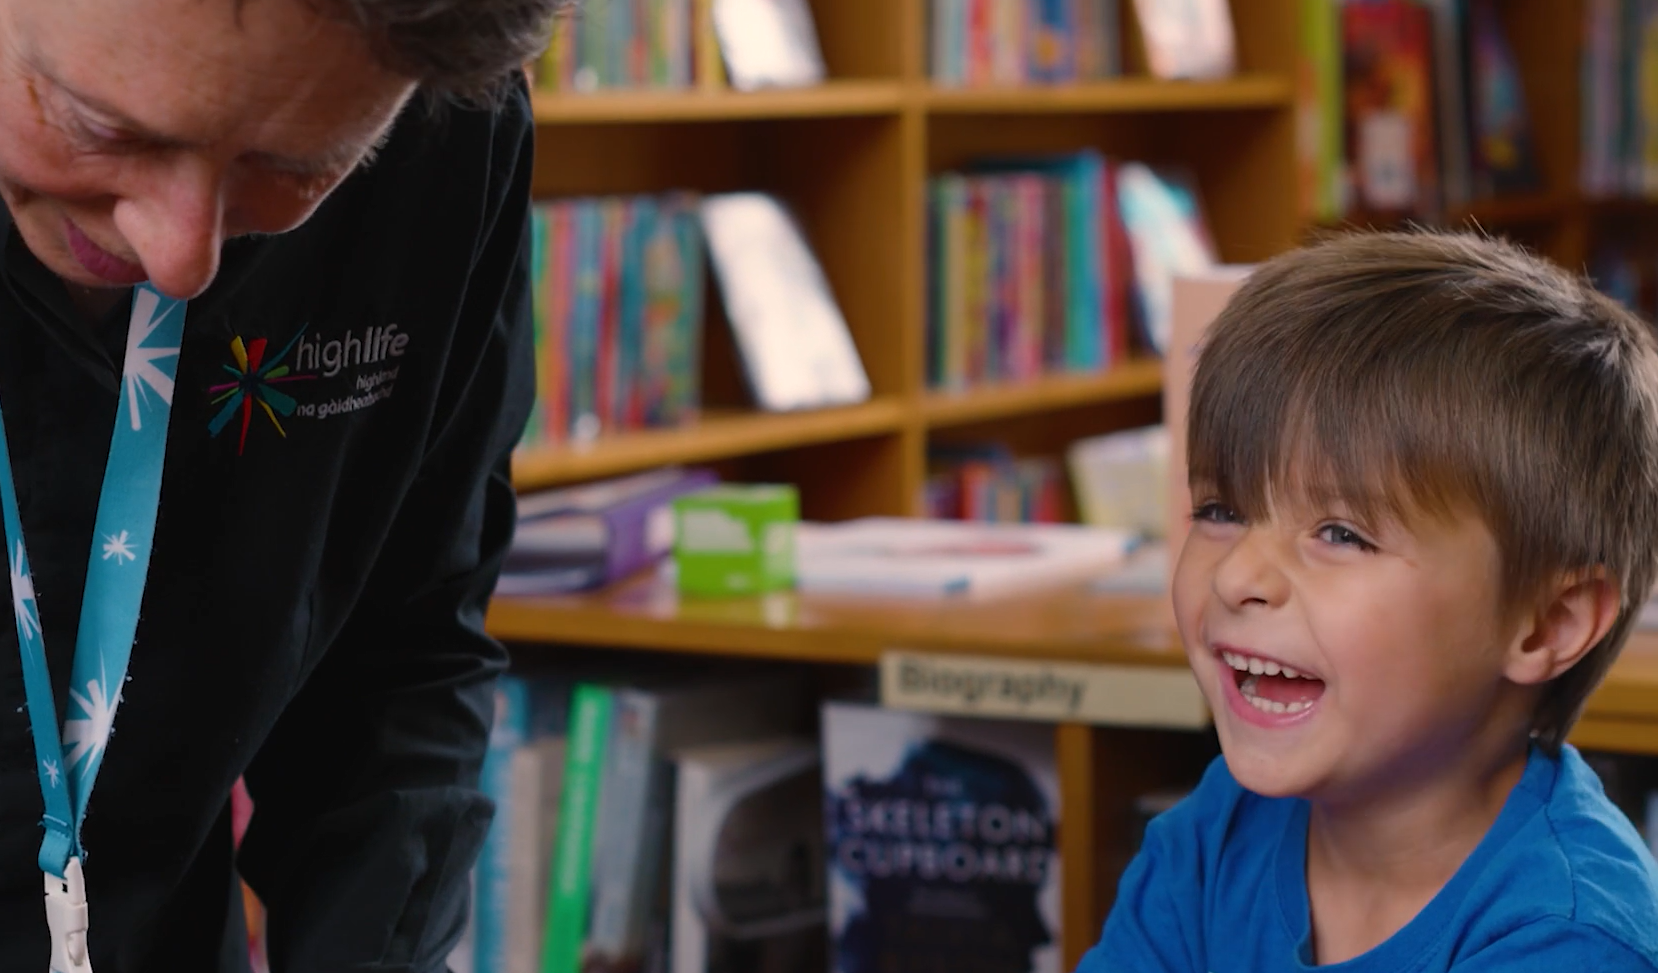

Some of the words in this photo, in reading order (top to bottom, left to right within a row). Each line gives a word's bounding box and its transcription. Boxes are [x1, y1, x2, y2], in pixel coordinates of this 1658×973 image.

[897, 655, 1088, 710] Biography
[843, 799, 1048, 845] SKELETON
[838, 836, 1049, 884] CUPBOARD
